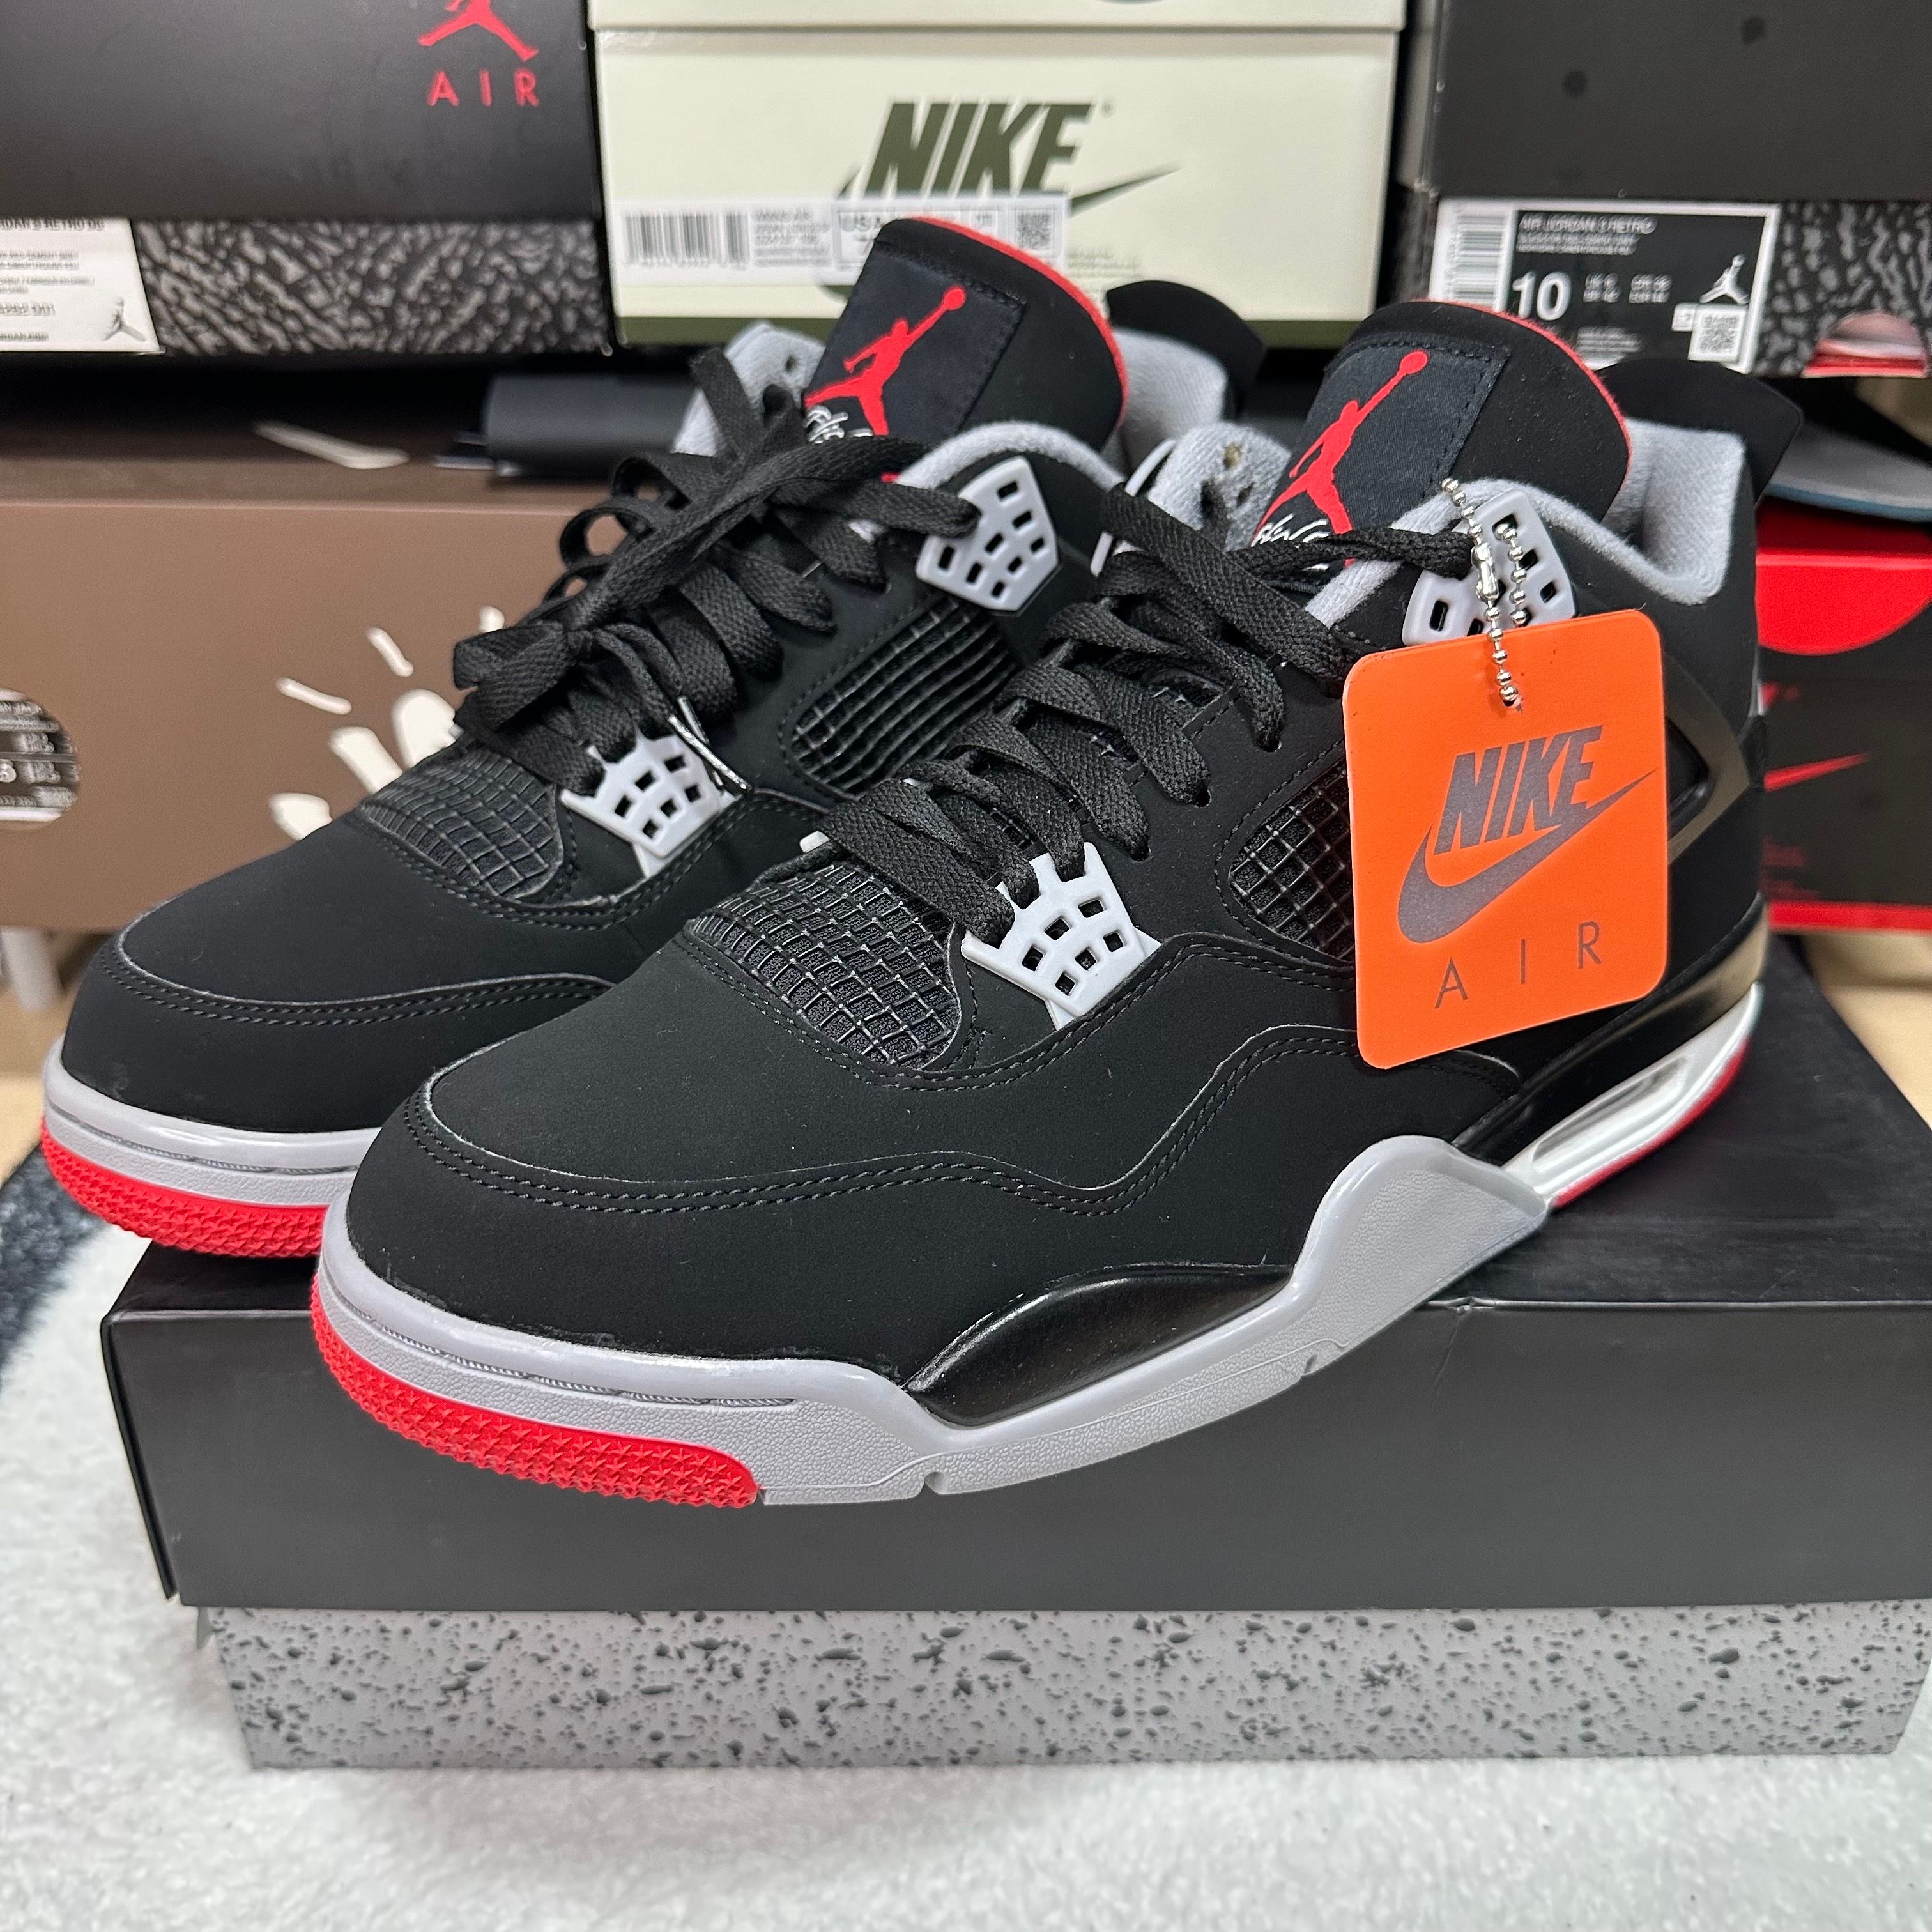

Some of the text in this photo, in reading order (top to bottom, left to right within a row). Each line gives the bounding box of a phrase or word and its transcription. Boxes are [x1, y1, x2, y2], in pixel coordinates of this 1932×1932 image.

[427, 68, 540, 107] AIR
[866, 103, 1092, 194] NIKE
[1512, 270, 1572, 321] 10
[1433, 725, 1603, 855] NIKE
[1435, 921, 1602, 1009] AIR
